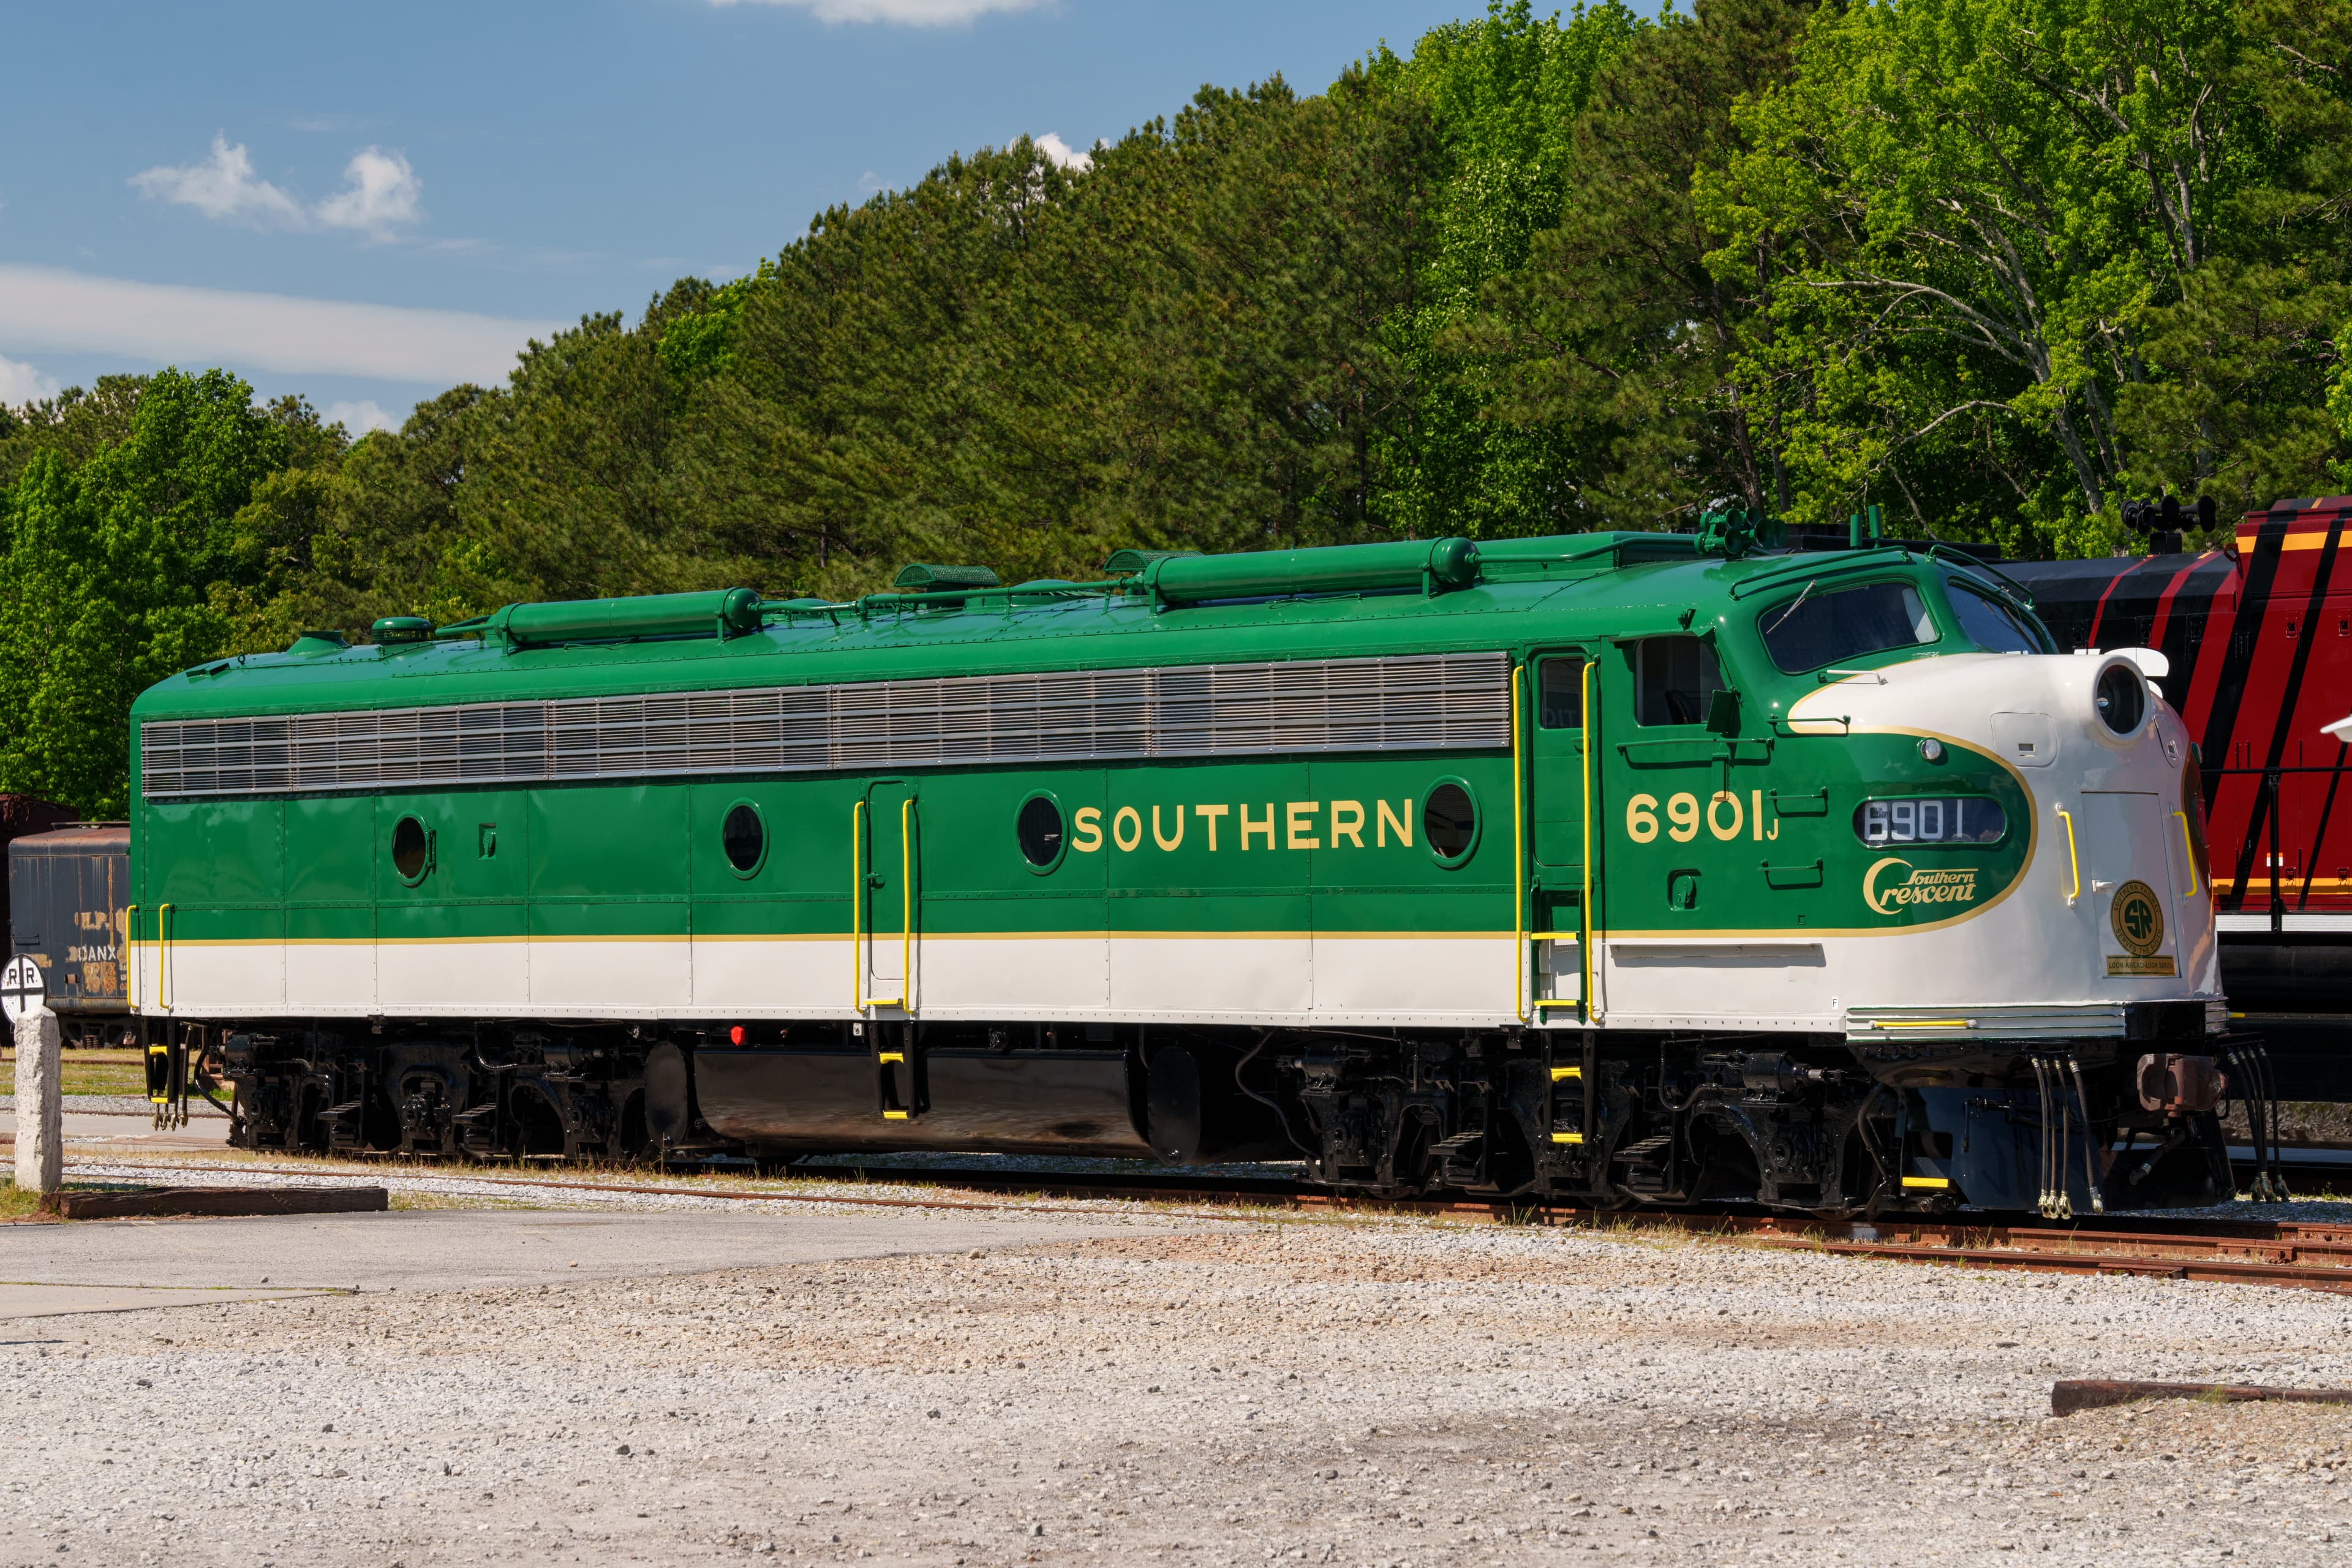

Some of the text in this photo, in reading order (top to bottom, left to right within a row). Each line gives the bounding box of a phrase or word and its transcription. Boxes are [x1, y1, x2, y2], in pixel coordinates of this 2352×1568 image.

[1072, 799, 1413, 853] SOUTHERN
[1864, 799, 1963, 841] 6901
[1863, 858, 1977, 915] Crescent
[1898, 868, 1979, 886] Southern
[2113, 884, 2160, 913] SOUTHERN RAILWAY
[2125, 899, 2153, 940] SR
[2116, 928, 2137, 952] SERVES
[2150, 929, 2162, 949] SOUTH
[1833, 998, 1838, 1008] F
